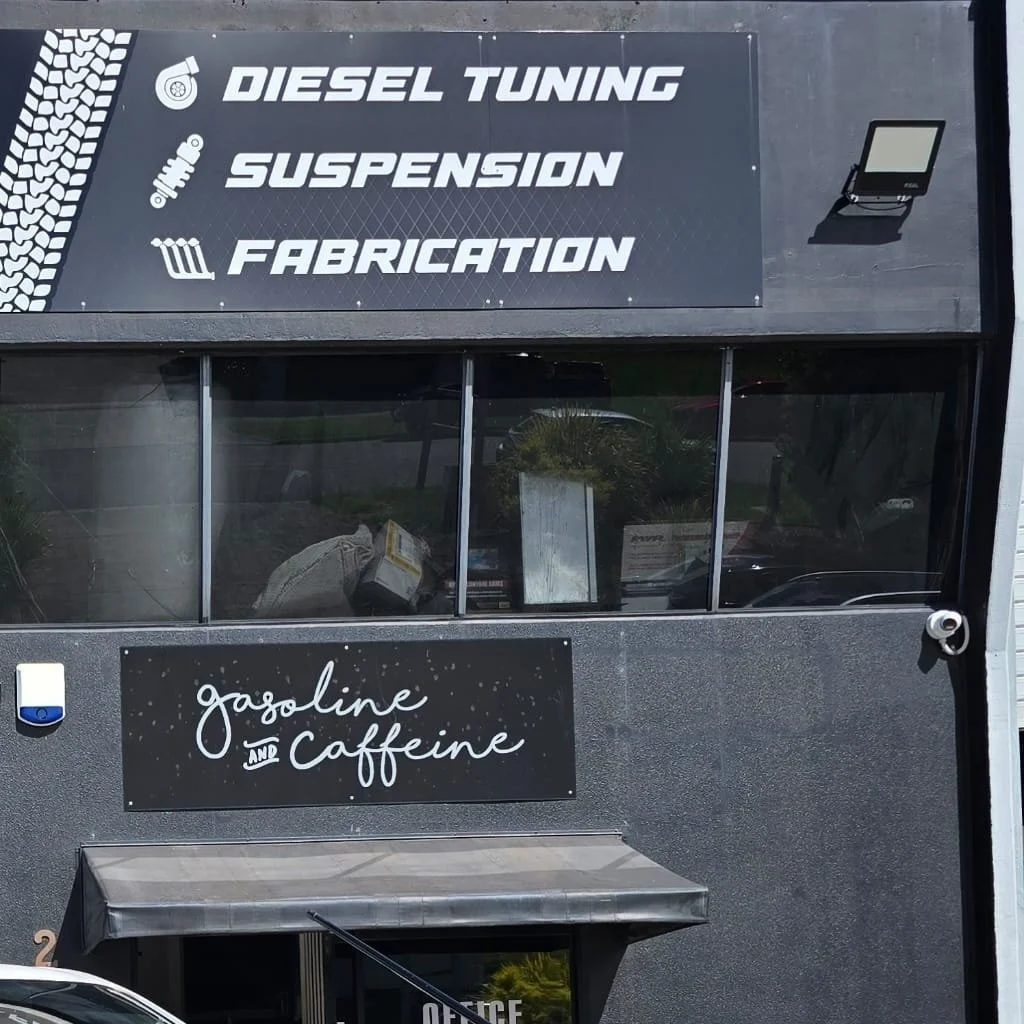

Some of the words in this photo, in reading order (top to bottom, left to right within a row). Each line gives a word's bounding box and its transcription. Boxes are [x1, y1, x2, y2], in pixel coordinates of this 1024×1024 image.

[222, 66, 444, 102] DIESEL
[464, 66, 684, 101] TUNING
[224, 151, 624, 188] SUSPENSION
[227, 237, 636, 275] FABRICATION
[195, 660, 428, 759] gasoline
[246, 741, 279, 766] AND
[34, 929, 57, 967] 2
